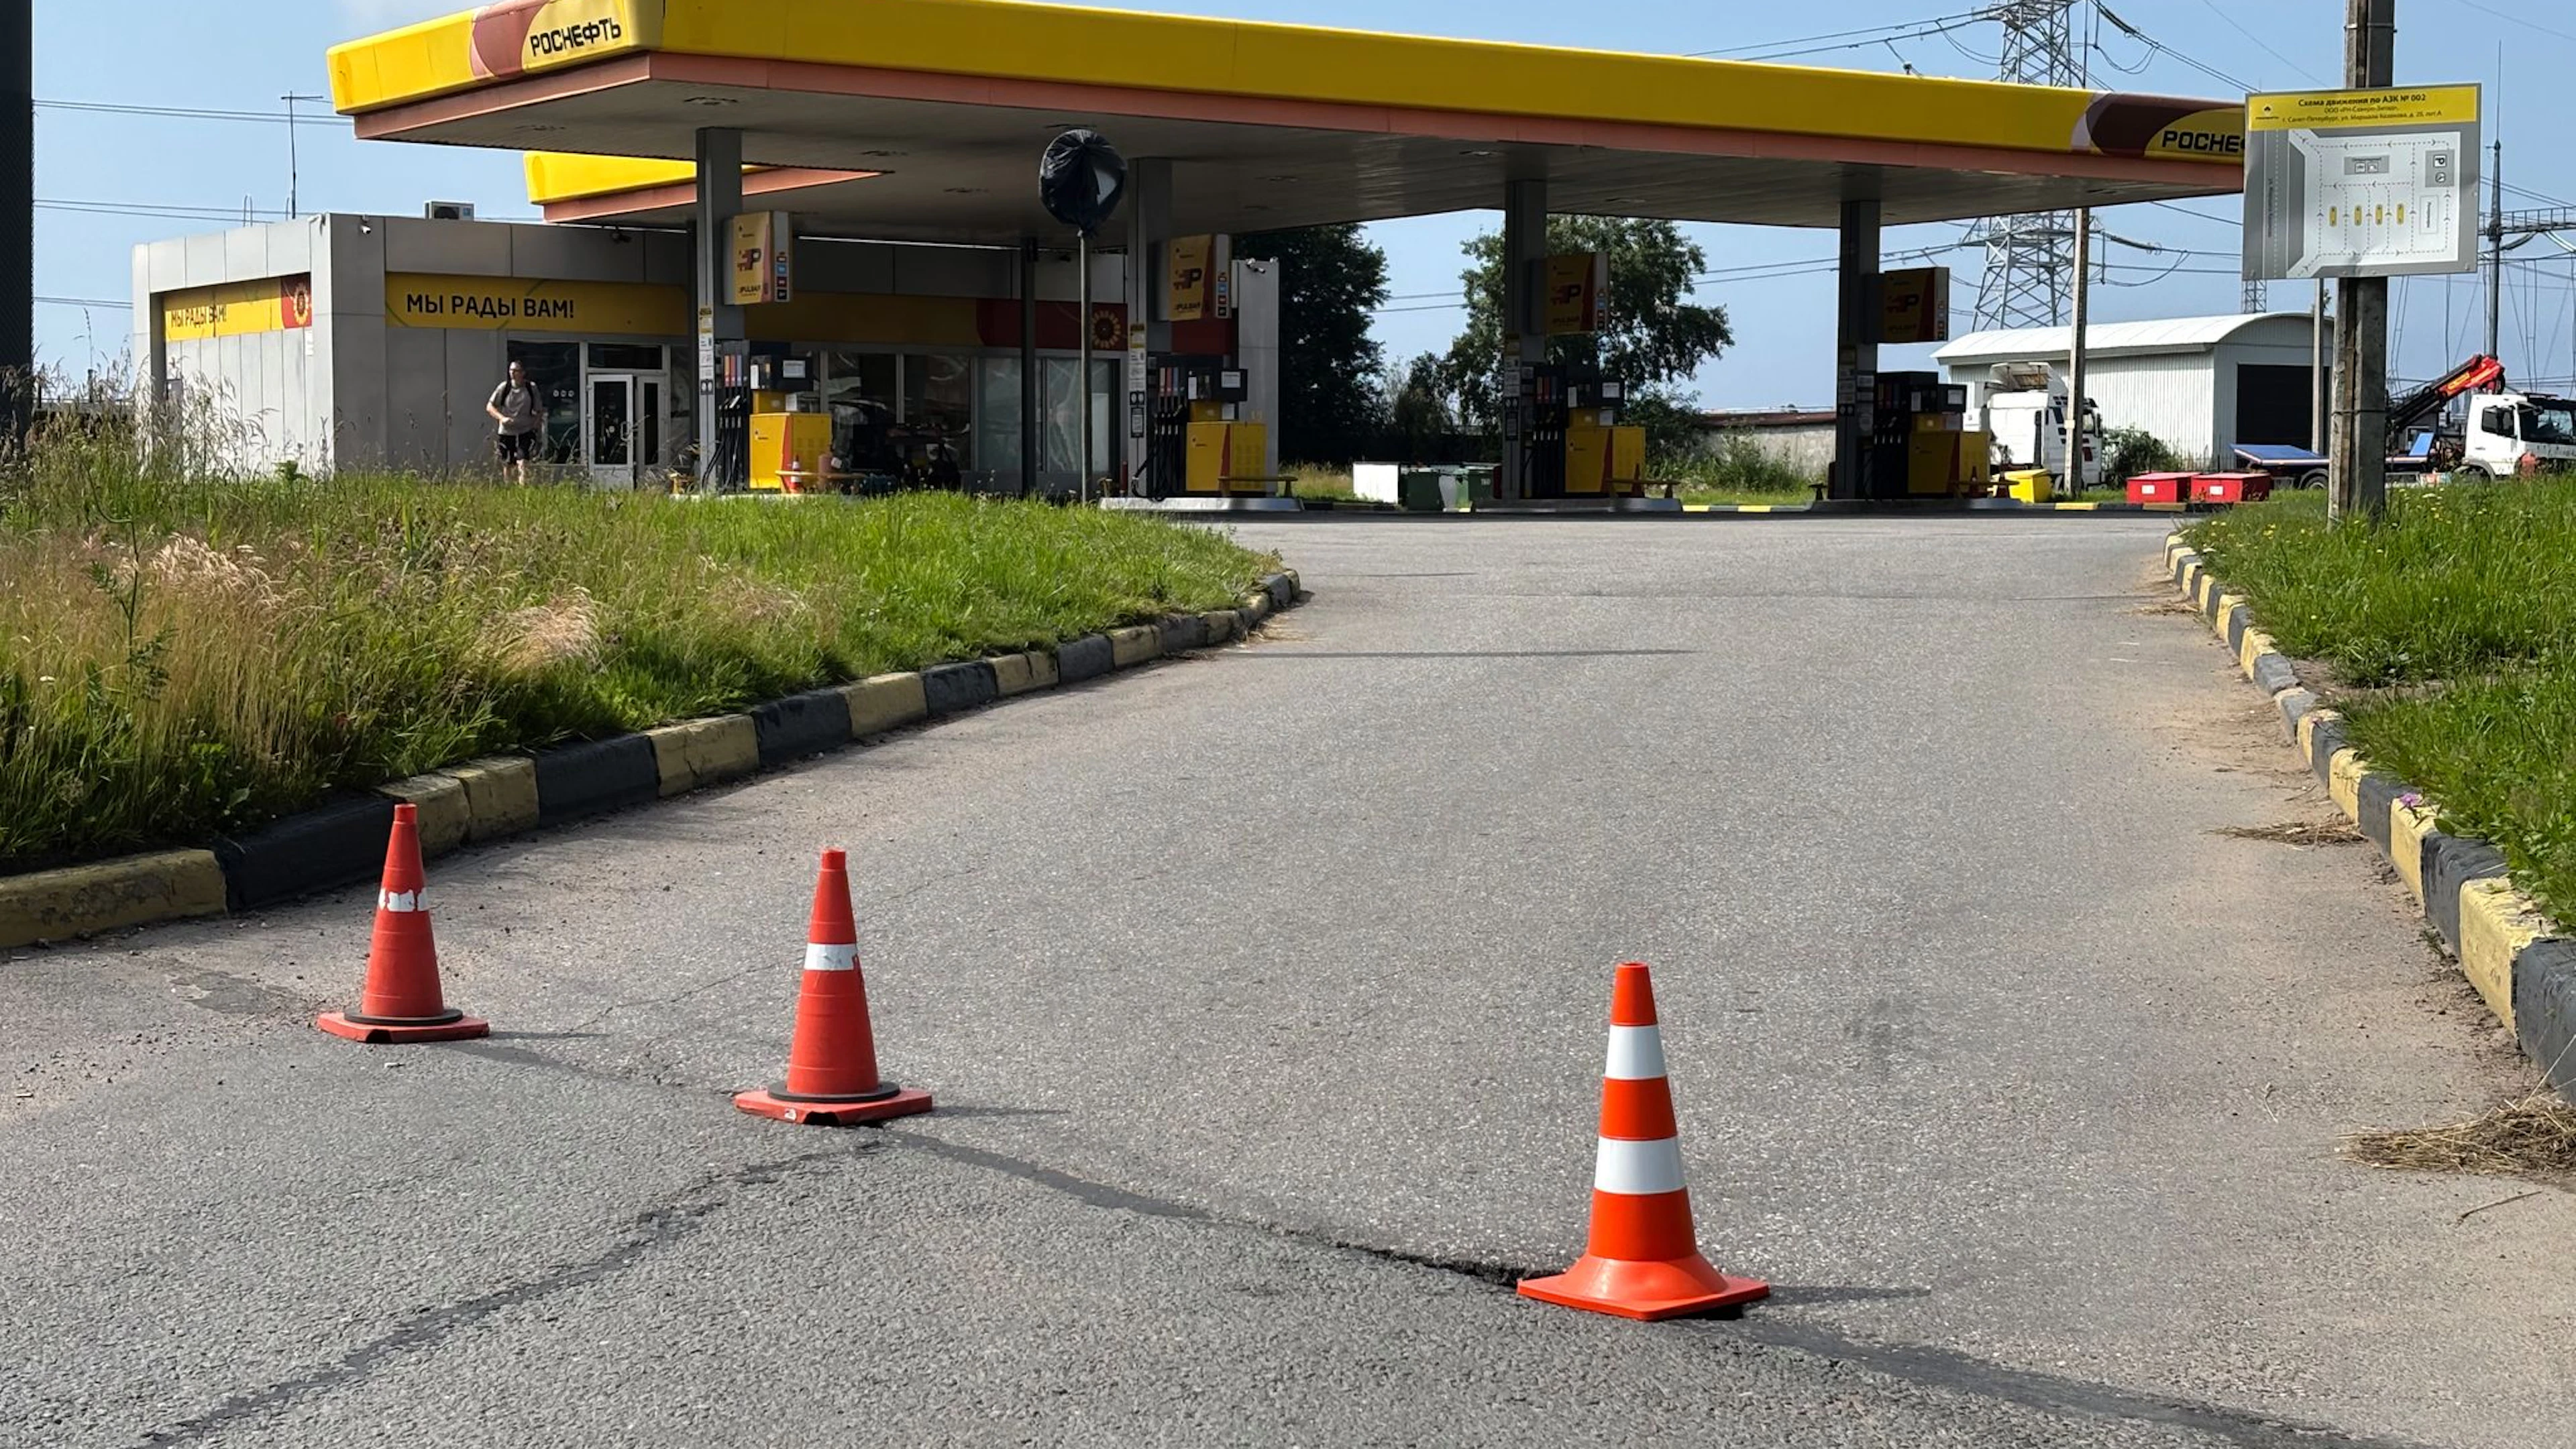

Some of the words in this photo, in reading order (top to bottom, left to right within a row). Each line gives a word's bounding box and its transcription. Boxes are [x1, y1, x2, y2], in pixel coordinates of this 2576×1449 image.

[529, 17, 622, 56] РОСНЕФТЬ
[2326, 98, 2368, 106] движения
[2411, 93, 2426, 101] 002
[2161, 130, 2245, 152] РОСНЕ
[171, 309, 184, 328] МЫ
[184, 306, 207, 328] РАДЫ
[407, 294, 443, 313] МЫ
[451, 295, 516, 318] РАДЫ
[524, 298, 574, 319] ВАМ!
